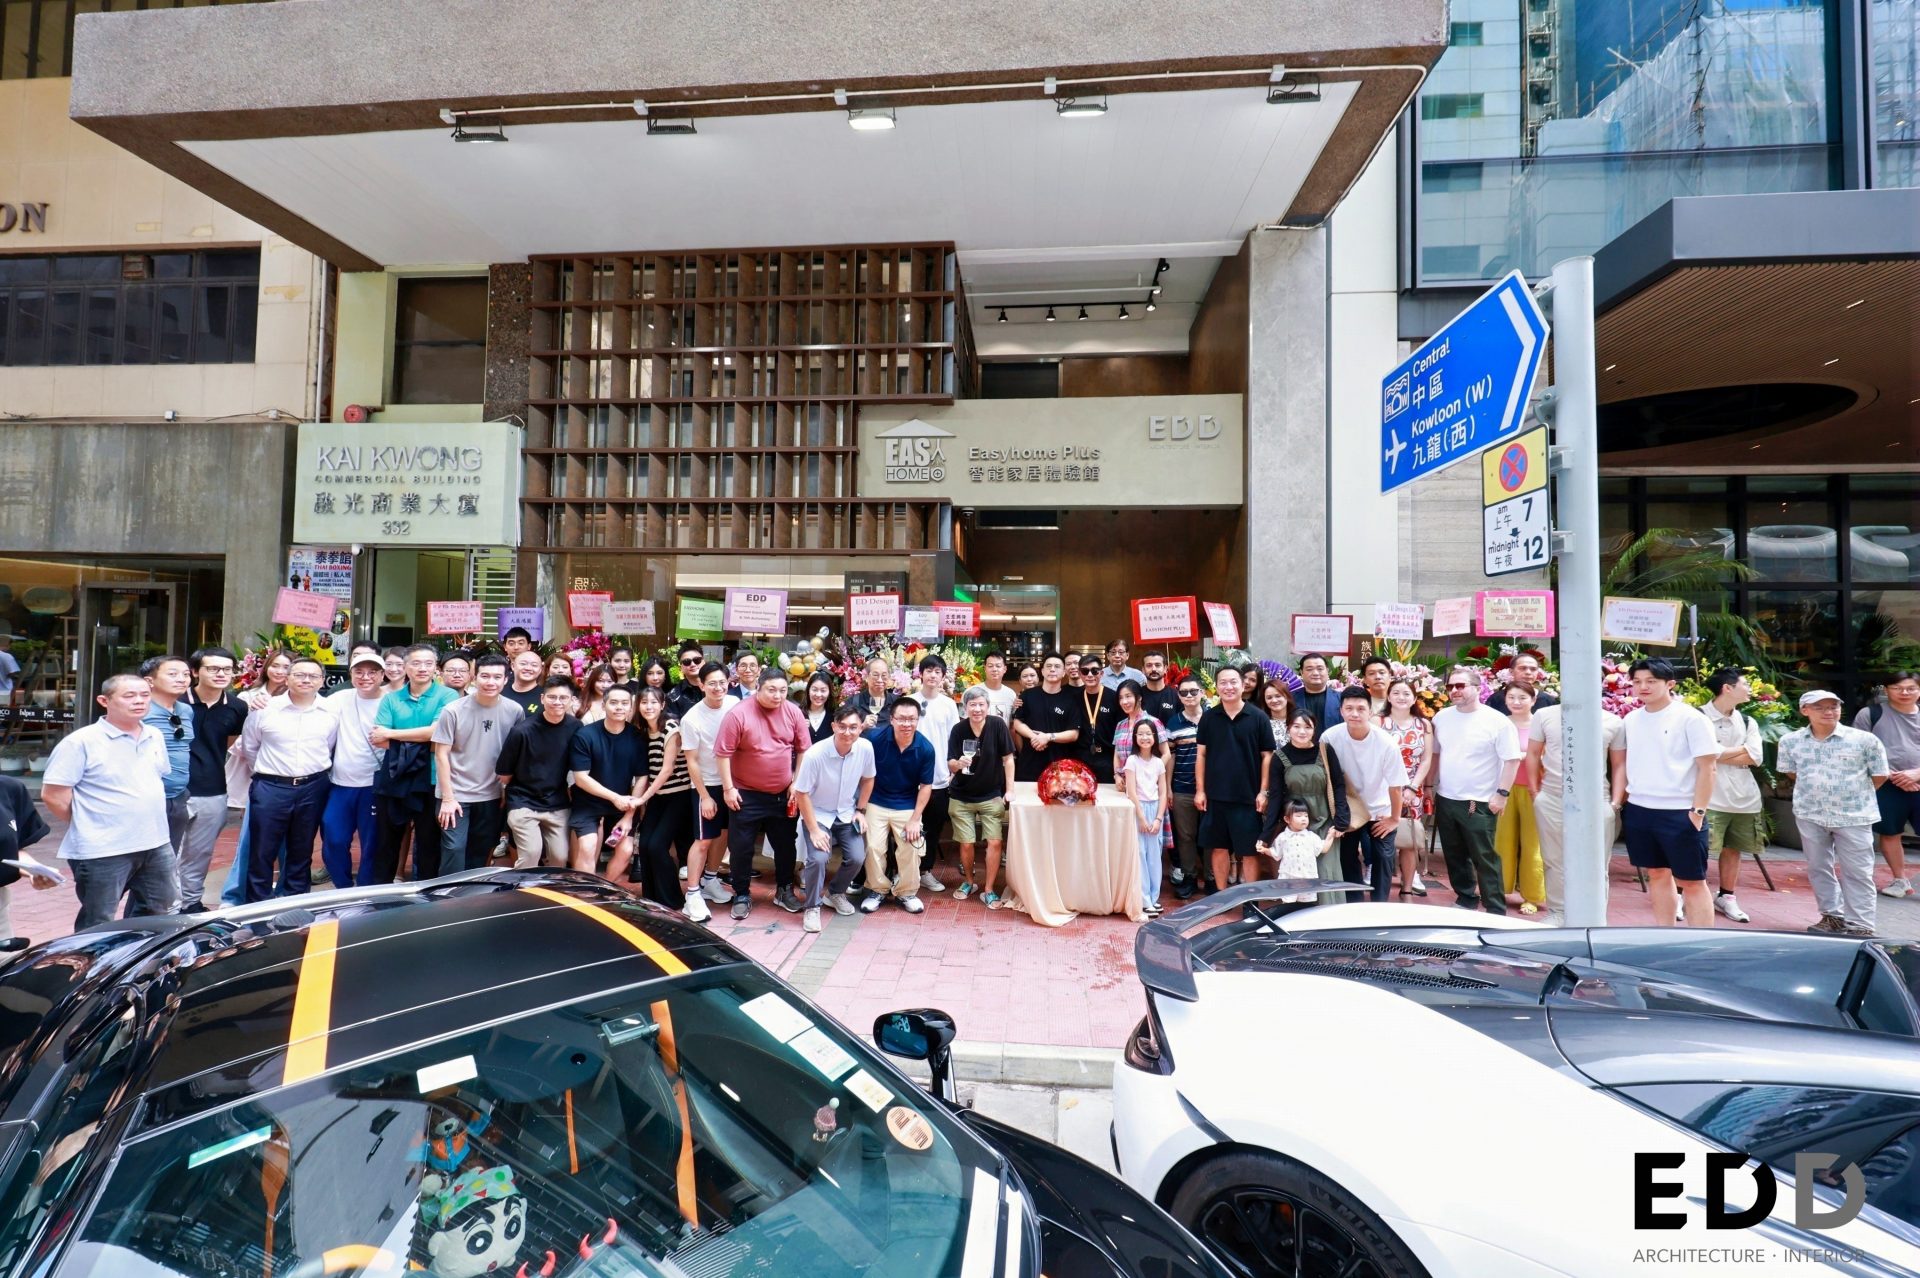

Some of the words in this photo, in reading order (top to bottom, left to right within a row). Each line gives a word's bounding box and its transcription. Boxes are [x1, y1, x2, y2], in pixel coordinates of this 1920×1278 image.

[1412, 368, 1444, 410] 中區
[1411, 399, 1461, 438] Kowloon
[1465, 374, 1492, 411] (W)
[1148, 415, 1221, 440] EDD
[1412, 415, 1476, 470] 九龍(西)
[316, 446, 363, 471] KAI
[371, 446, 483, 471] KWONG
[968, 446, 1057, 463] Easyhome
[1062, 446, 1100, 459] Plus
[314, 475, 406, 484] COMMERCIAL
[413, 475, 482, 484] BUILDING
[886, 467, 929, 481] HOME
[968, 465, 1100, 483] 智能家居體驗館
[1497, 504, 1508, 515] am
[1522, 497, 1533, 522] 7
[1494, 513, 1512, 531] 上午
[1488, 535, 1519, 555] midnight
[1523, 535, 1544, 562] 12
[316, 551, 352, 564] 泰拳館
[1494, 546, 1513, 567] 午夜
[746, 594, 767, 602] EDD
[869, 597, 895, 605] Design
